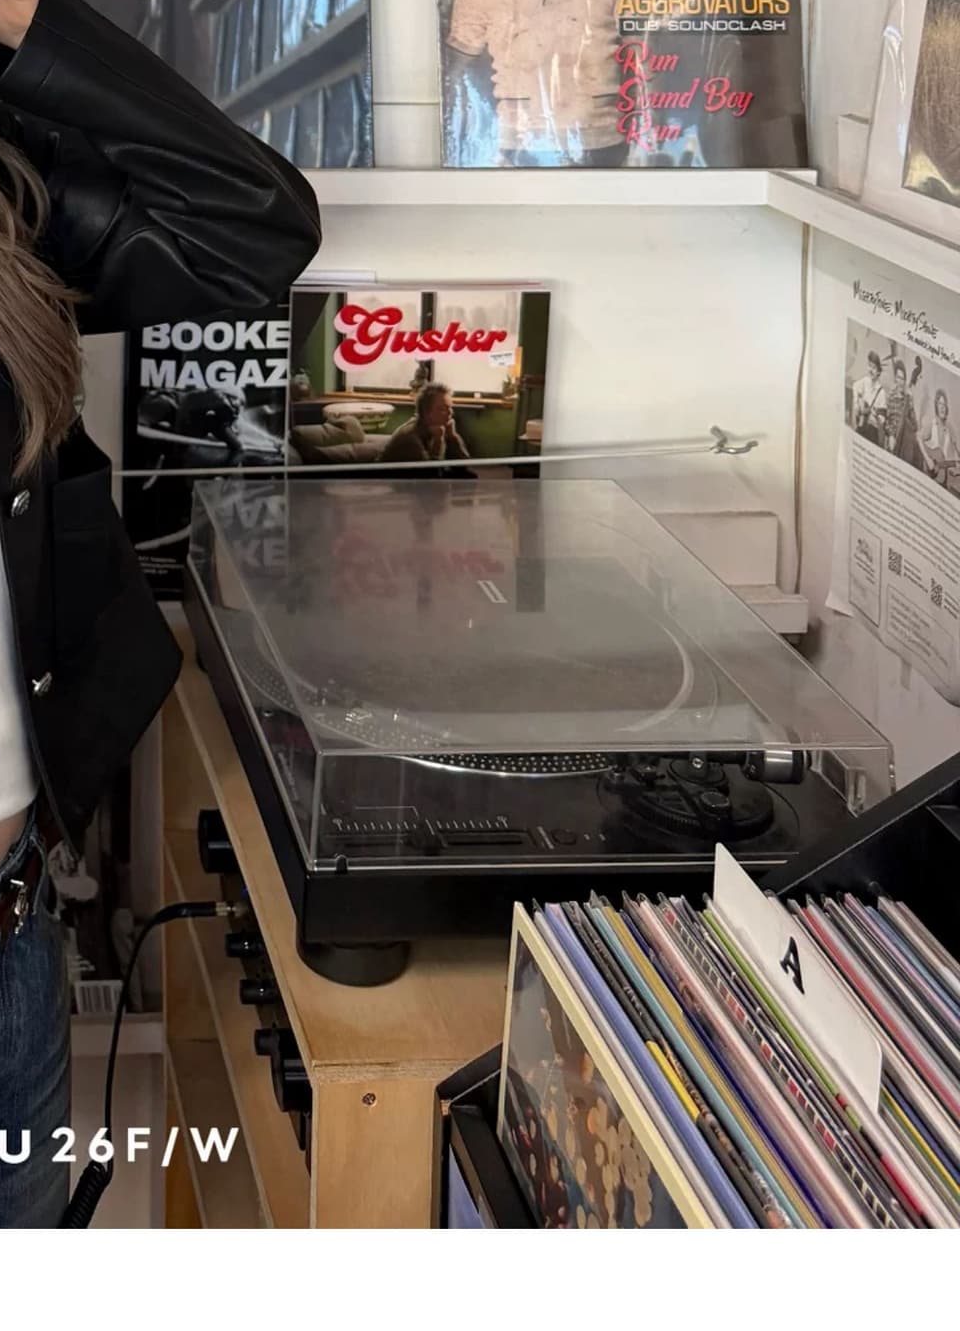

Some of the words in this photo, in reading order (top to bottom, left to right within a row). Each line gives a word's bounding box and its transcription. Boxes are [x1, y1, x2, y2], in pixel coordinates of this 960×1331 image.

[623, 19, 659, 31] DUB
[667, 19, 787, 32] SOUNDCLASH
[613, 41, 680, 81] Run
[703, 76, 754, 117] Boy
[336, 303, 509, 368] Gusher
[780, 936, 806, 996] A
